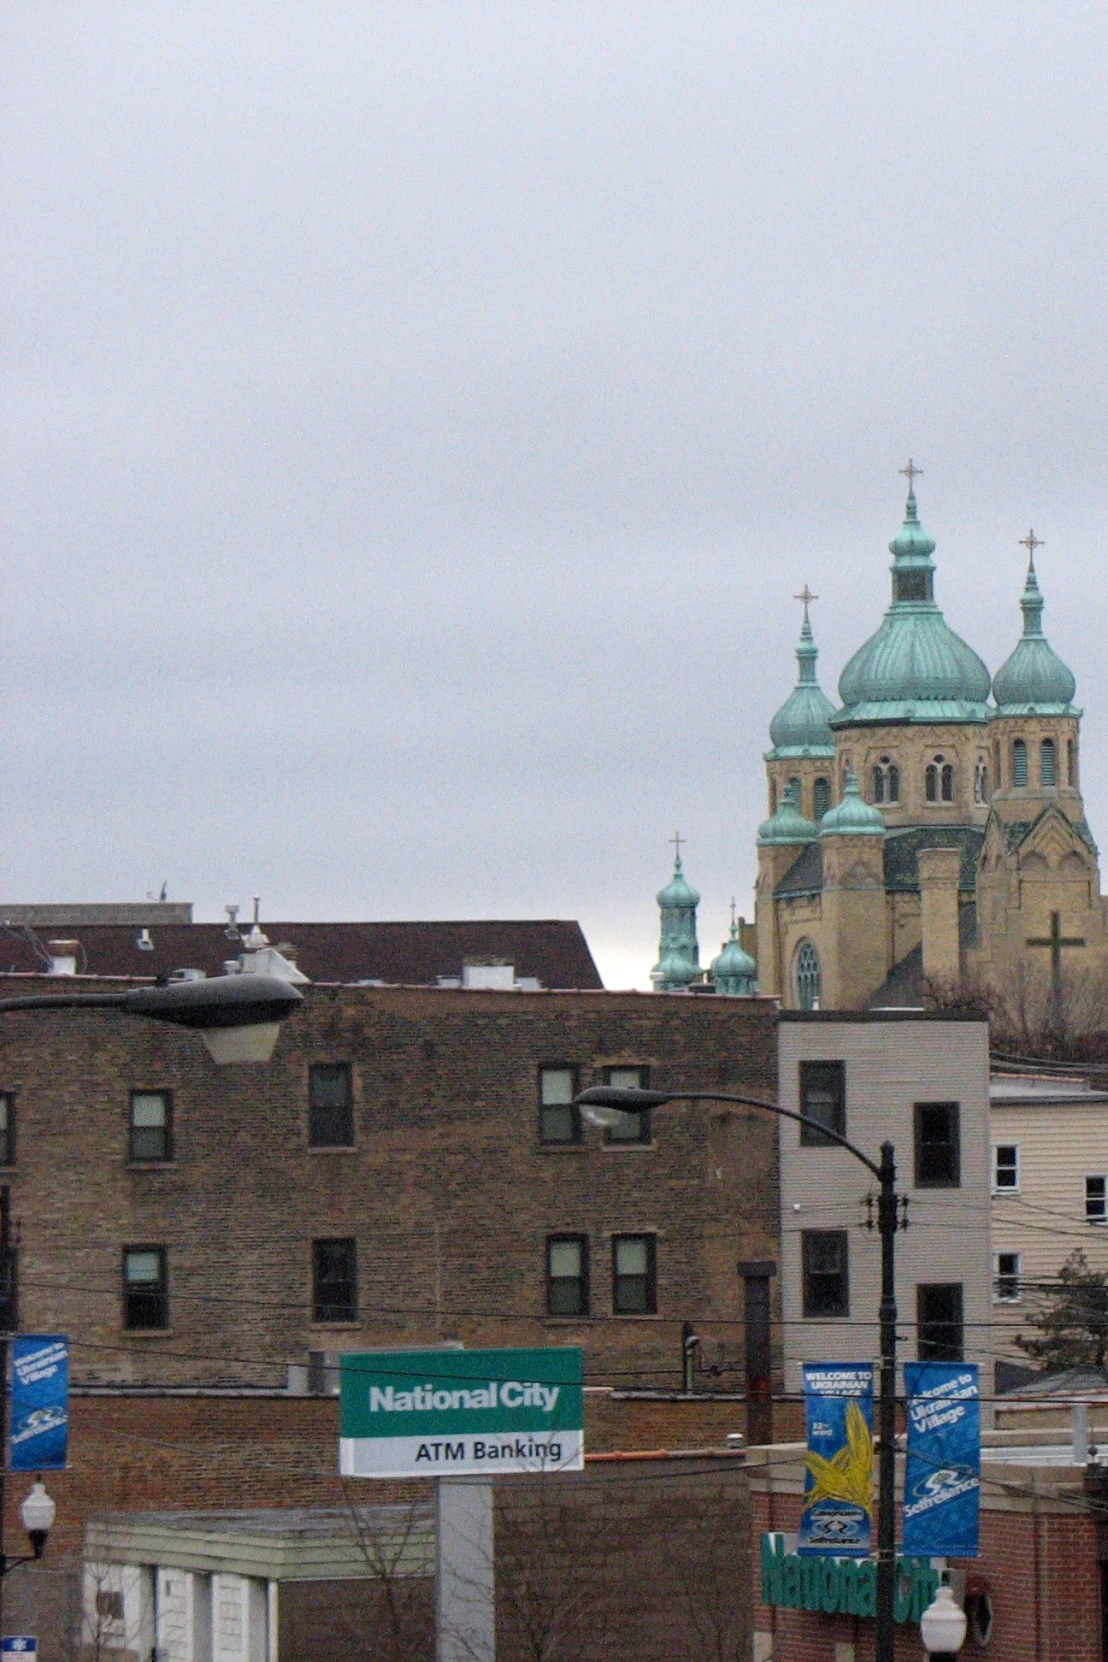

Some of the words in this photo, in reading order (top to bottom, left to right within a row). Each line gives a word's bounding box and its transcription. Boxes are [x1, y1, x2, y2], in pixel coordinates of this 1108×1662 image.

[805, 1372, 857, 1381] WELCOME
[857, 1371, 873, 1380] TO
[958, 1373, 973, 1385] to
[914, 1406, 967, 1433] Village
[415, 1442, 465, 1462] ATM
[473, 1439, 562, 1462] Banking
[903, 1477, 980, 1518] Selfreliance
[761, 1532, 878, 1618] Nationa
